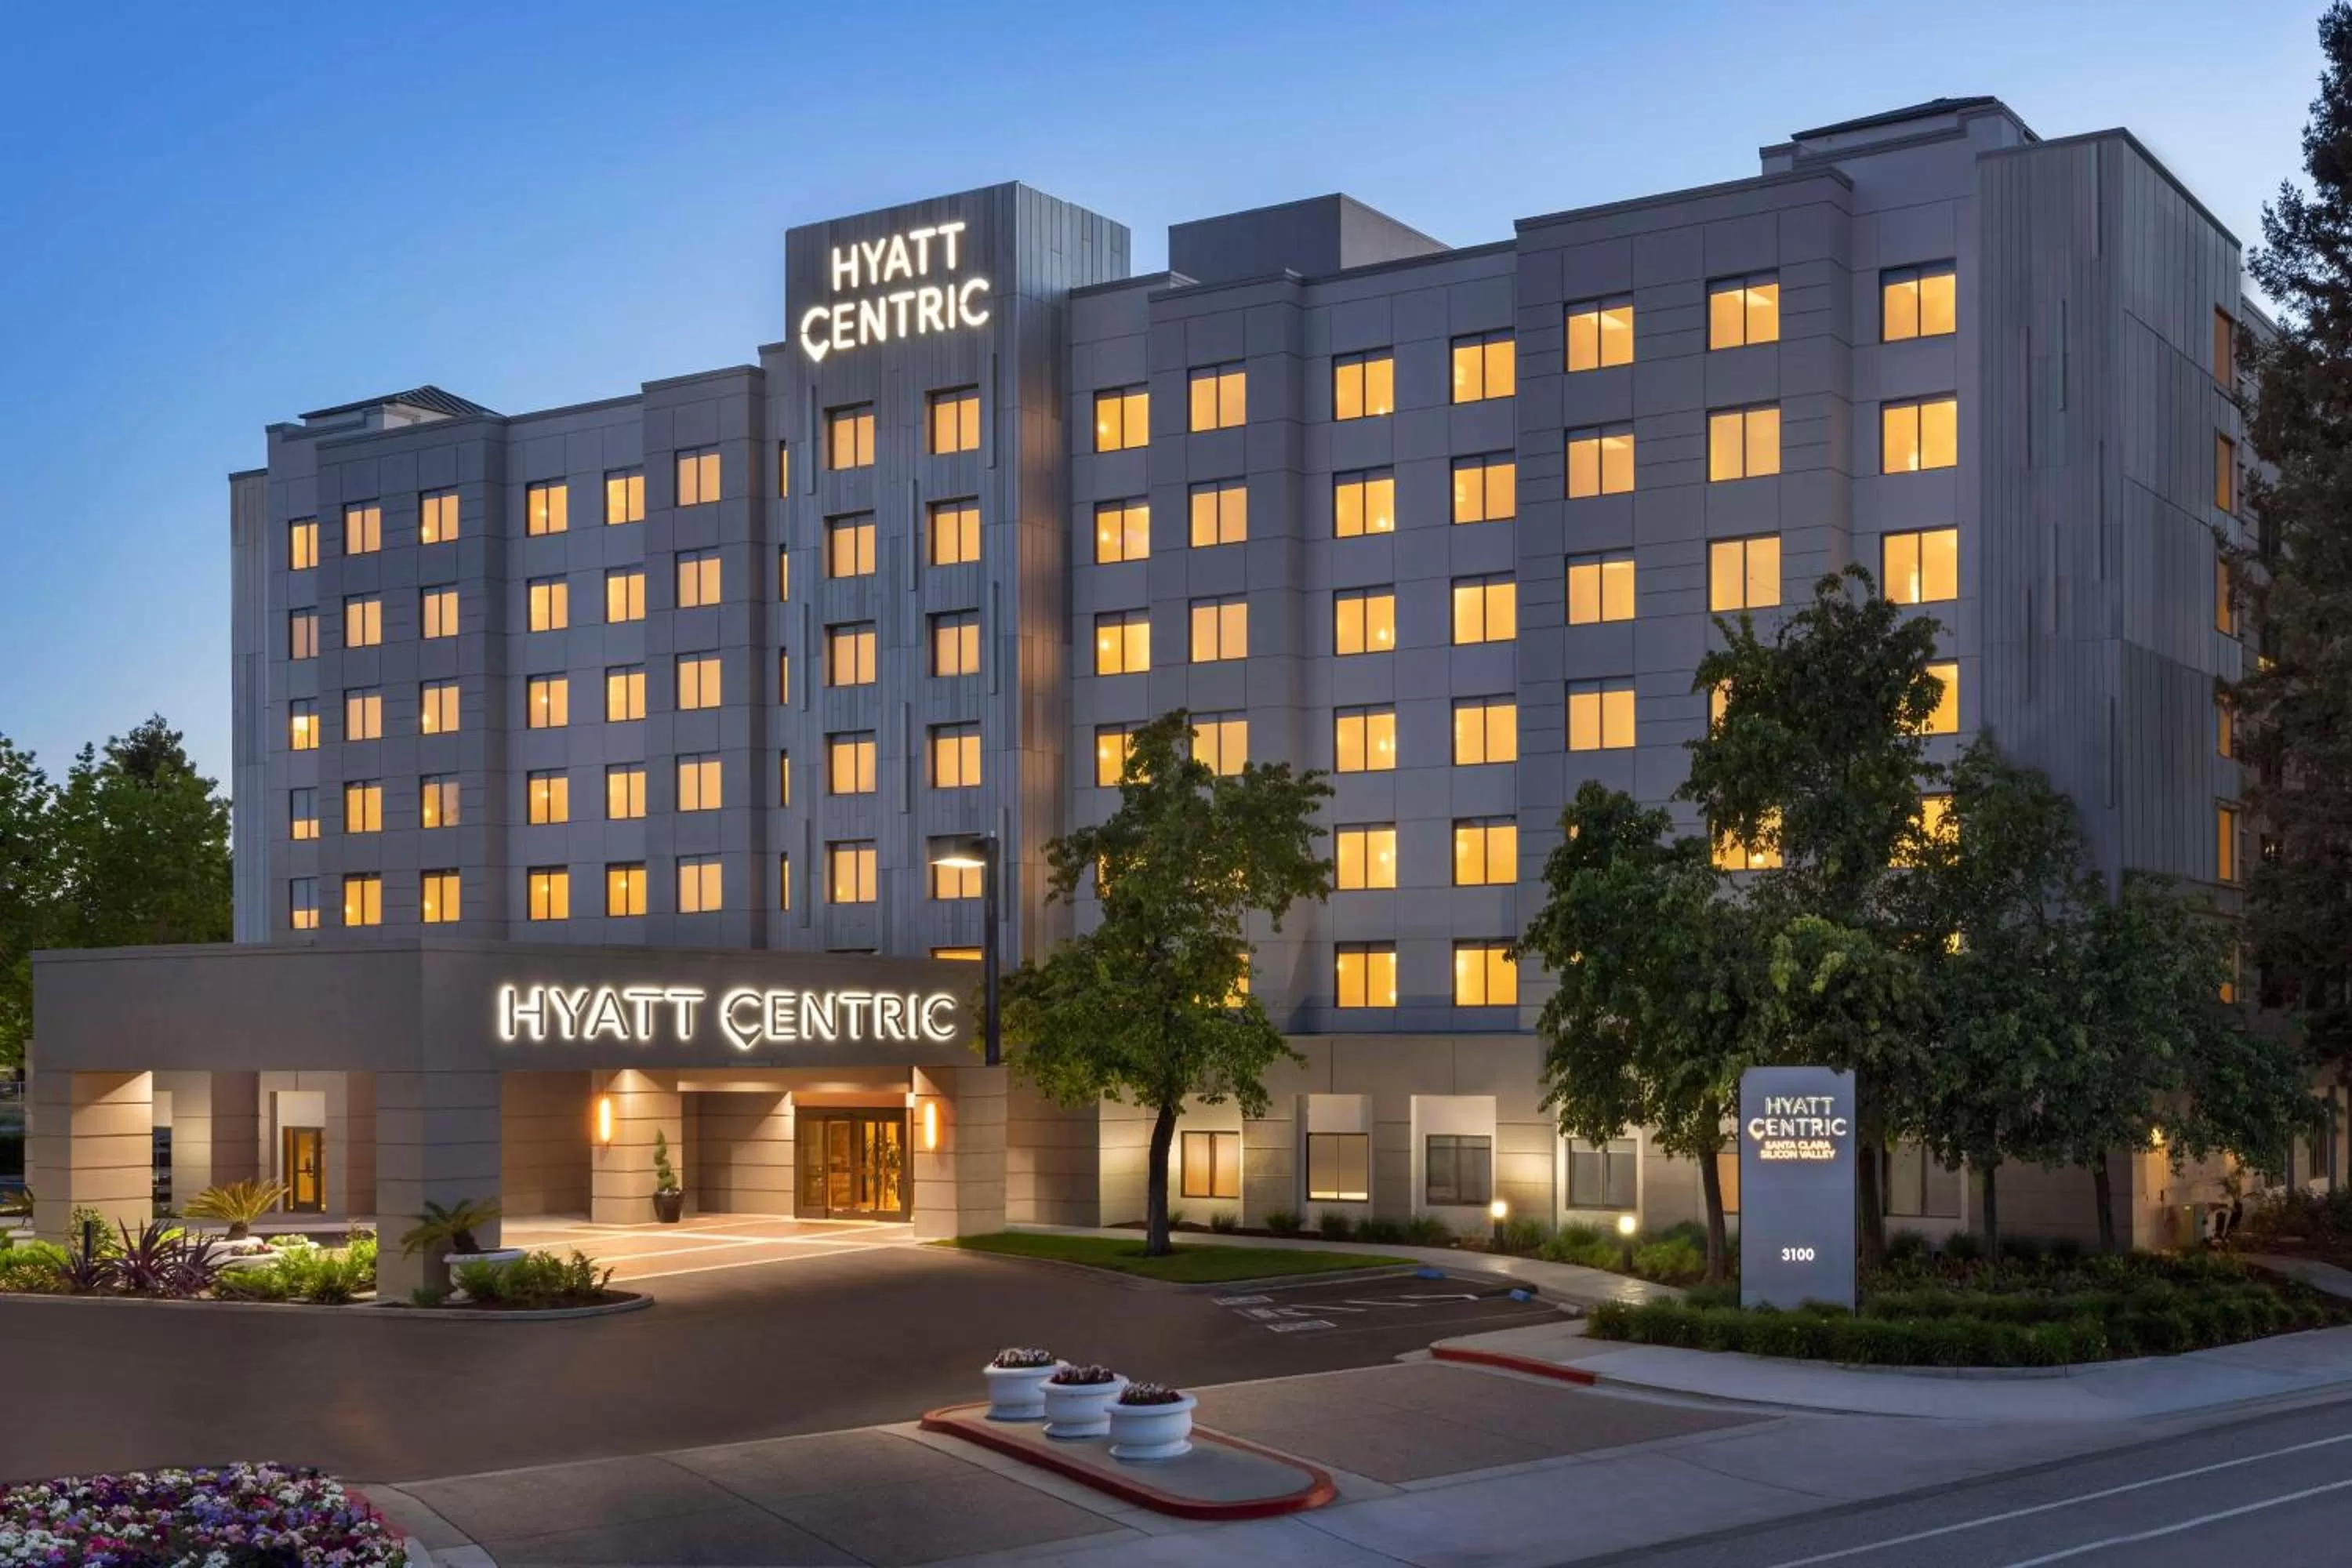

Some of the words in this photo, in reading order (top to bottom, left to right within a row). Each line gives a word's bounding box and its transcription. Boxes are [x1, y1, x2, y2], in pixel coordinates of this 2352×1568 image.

[832, 222, 966, 292] HYATT
[800, 278, 990, 363] CENTRIC
[499, 984, 705, 1041] HYATT
[720, 988, 957, 1049] CENTRIC
[1765, 1097, 1835, 1115] HYATT
[1748, 1117, 1847, 1140] CENTRIC
[1760, 1149, 1798, 1159] SILICON
[1799, 1149, 1836, 1159] VALLEY
[1765, 1141, 1796, 1150] SANTA
[1798, 1141, 1831, 1150] CLARA
[1781, 1247, 1815, 1261] 3100
